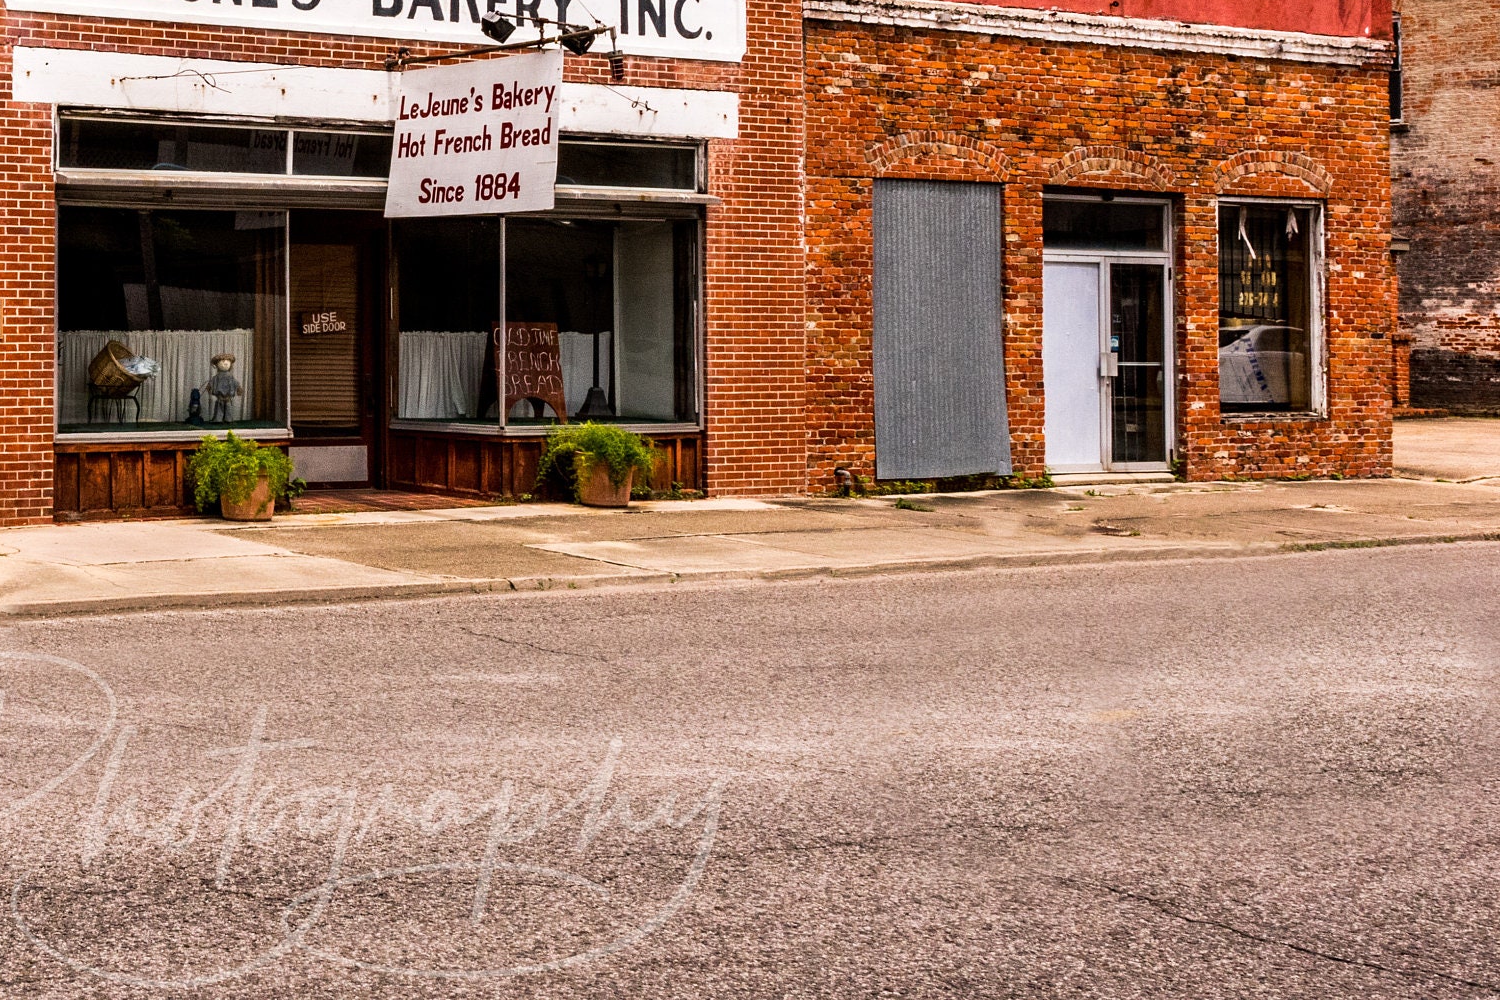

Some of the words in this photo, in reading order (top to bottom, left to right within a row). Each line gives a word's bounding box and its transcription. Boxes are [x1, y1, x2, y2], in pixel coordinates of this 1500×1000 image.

[399, 87, 484, 121] LeJeune's
[491, 80, 556, 113] Bakery
[397, 132, 426, 159] Hot
[433, 124, 492, 155] French
[499, 116, 552, 150] Bread
[418, 177, 465, 204] Since
[474, 172, 521, 201] 1884
[302, 323, 321, 334] SIDE
[322, 321, 347, 333] DOOR
[312, 311, 337, 324] USE
